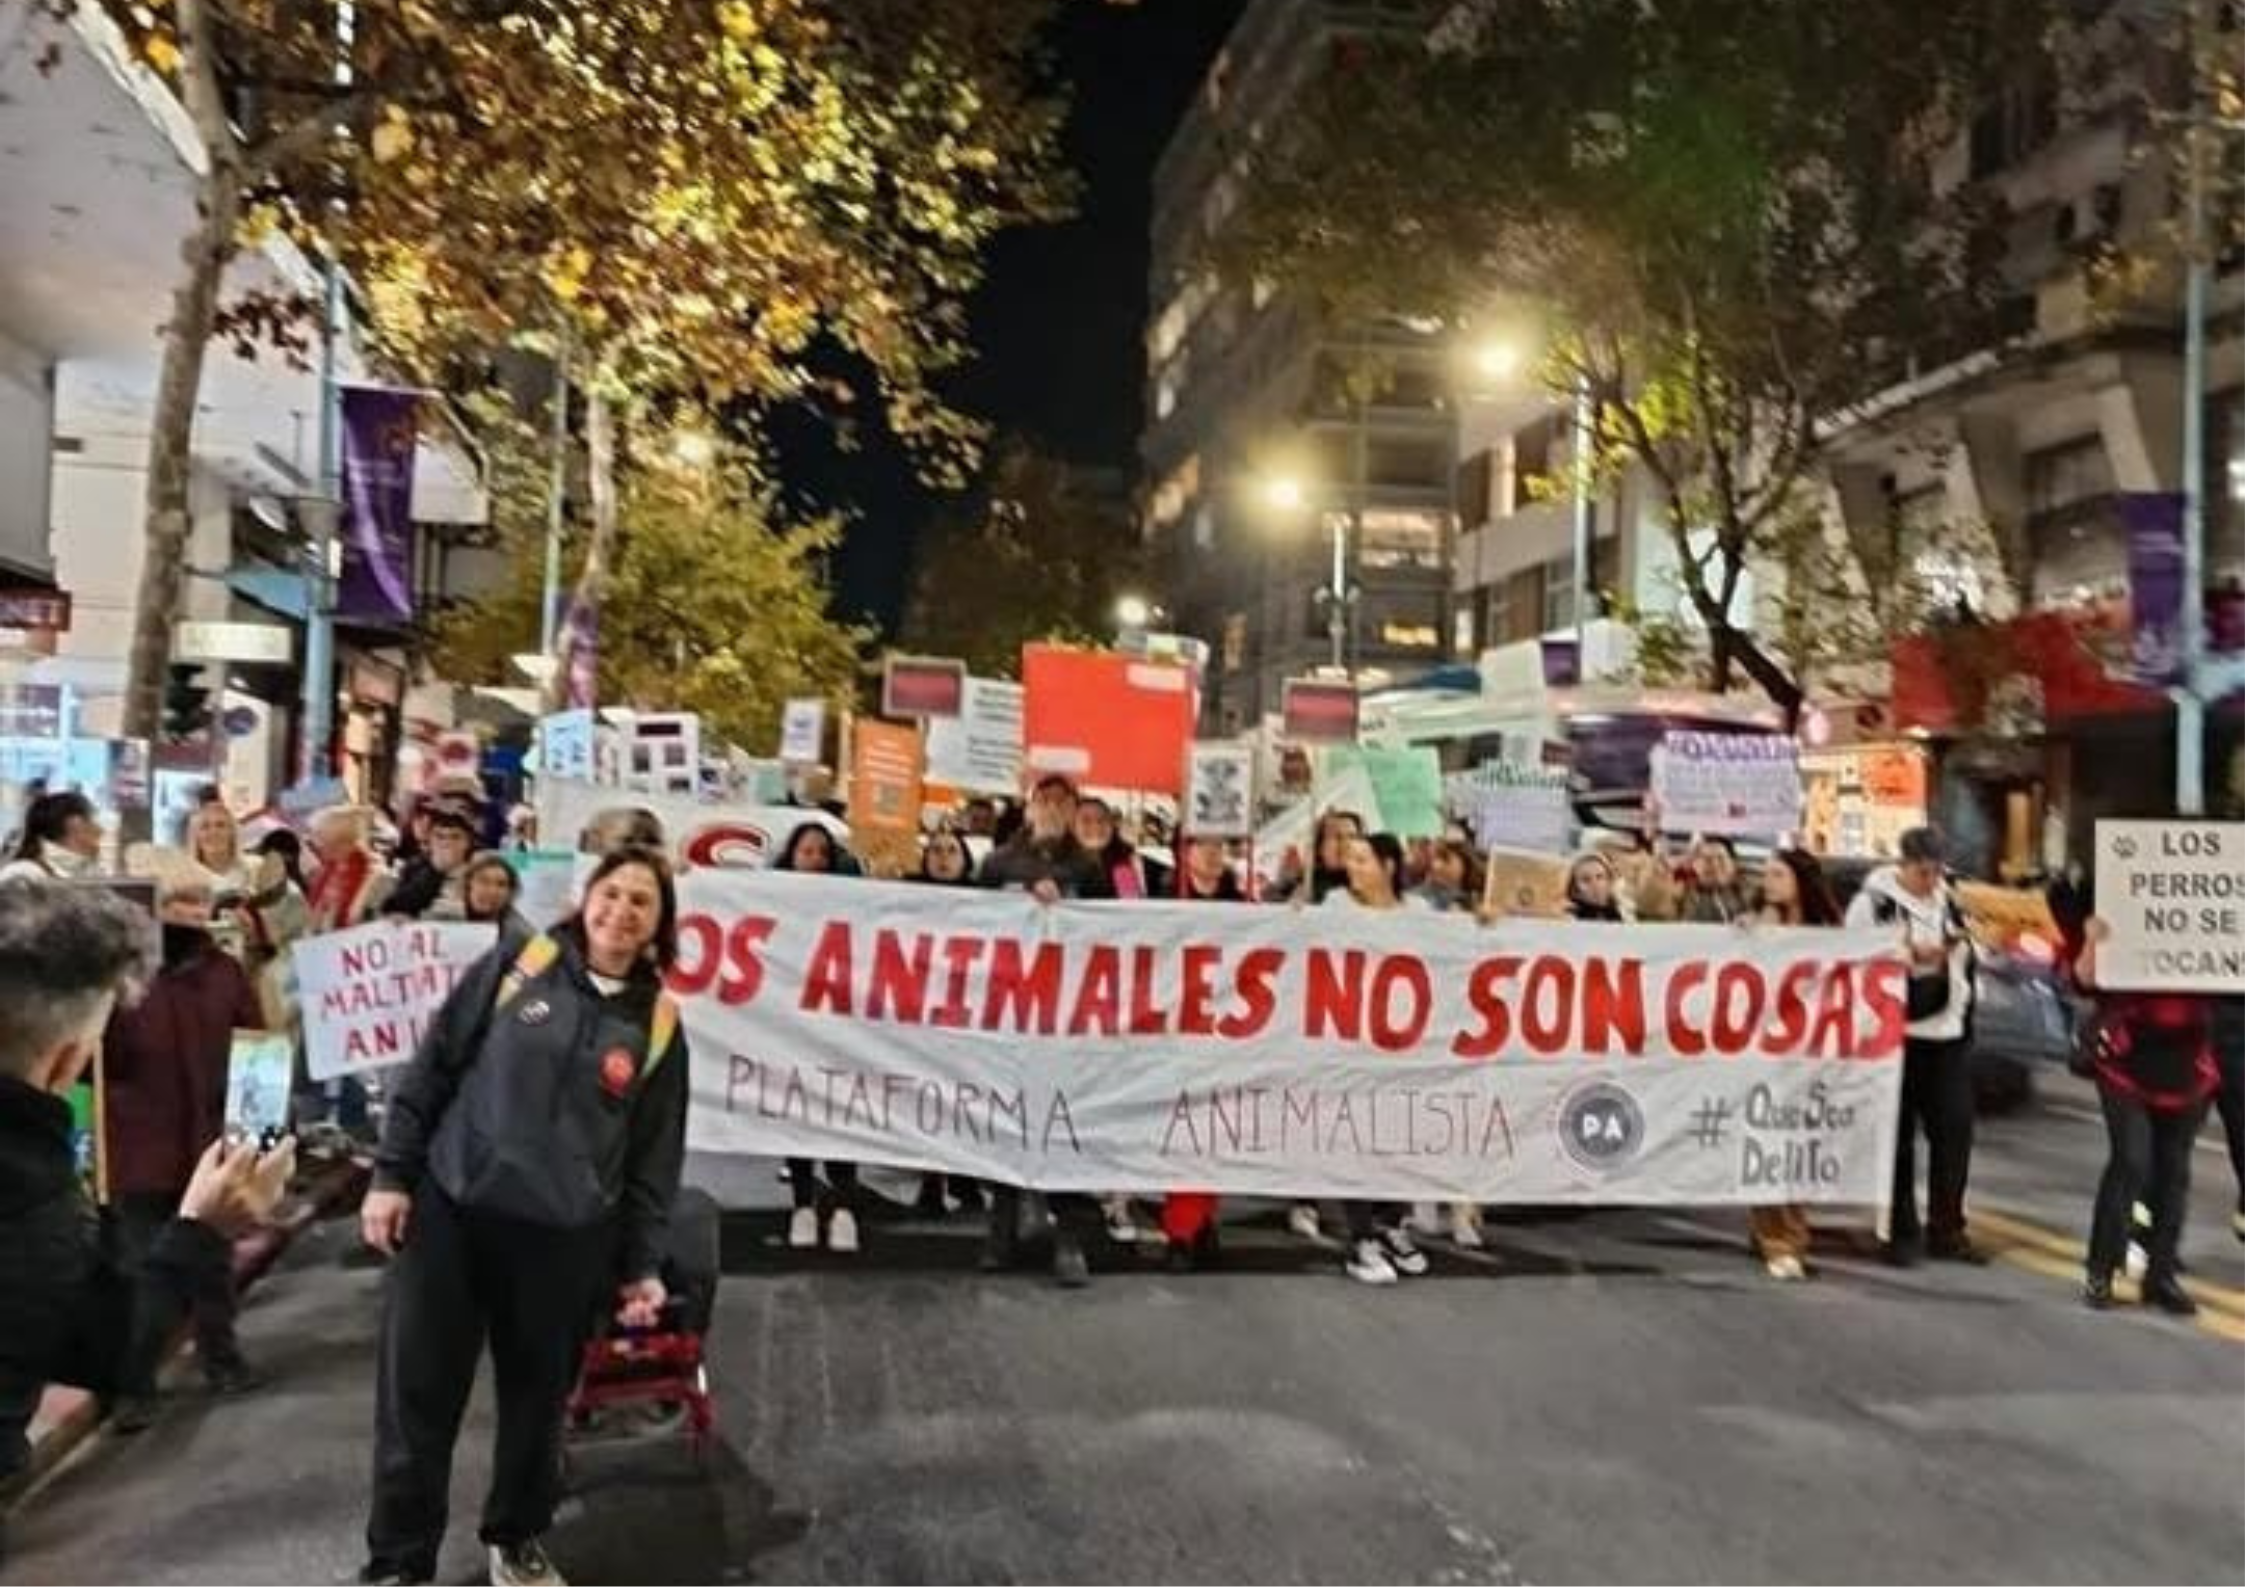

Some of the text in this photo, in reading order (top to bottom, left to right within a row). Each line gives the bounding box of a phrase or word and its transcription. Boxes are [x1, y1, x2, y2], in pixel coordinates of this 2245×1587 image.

[2162, 831, 2221, 856] LOS
[2145, 907, 2237, 934] NO SE
[341, 938, 388, 976] NO
[800, 920, 1285, 1037] ANIMALES
[1301, 947, 1433, 1053] NO
[1450, 953, 1647, 1059] SON
[1664, 957, 1905, 1060] COSAS
[725, 1054, 1515, 1161] PLATAFORMA ANIMALISTA
[1582, 1113, 1623, 1141] PA
